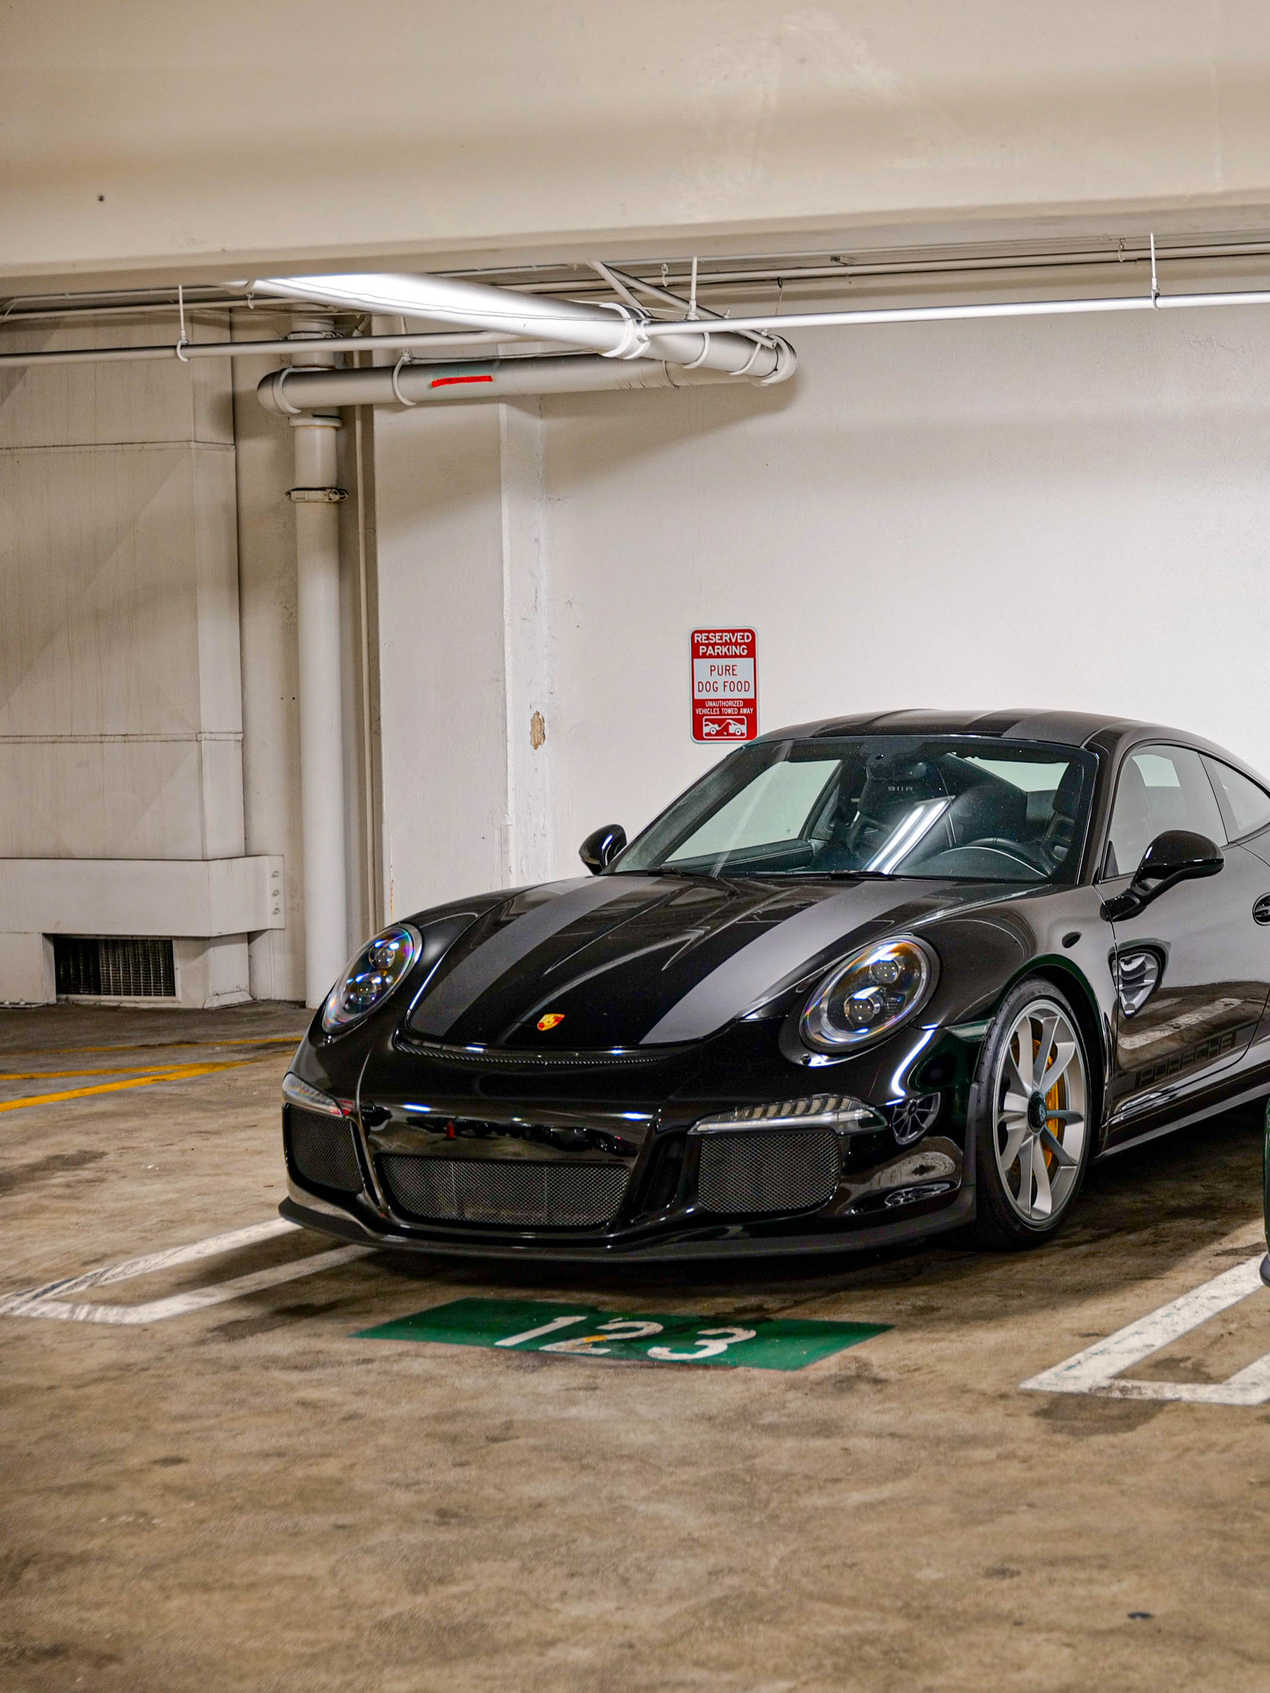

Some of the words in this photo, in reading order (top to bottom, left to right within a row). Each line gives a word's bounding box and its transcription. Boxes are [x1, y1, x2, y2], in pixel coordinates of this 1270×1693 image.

[694, 632, 752, 643] RESERVED
[699, 645, 748, 656] PARKING
[709, 664, 738, 676] PURE
[697, 680, 719, 692] DOG
[723, 680, 751, 692] FOOD
[1139, 1033, 1233, 1087] PORSCHE
[494, 1315, 757, 1361] 123
